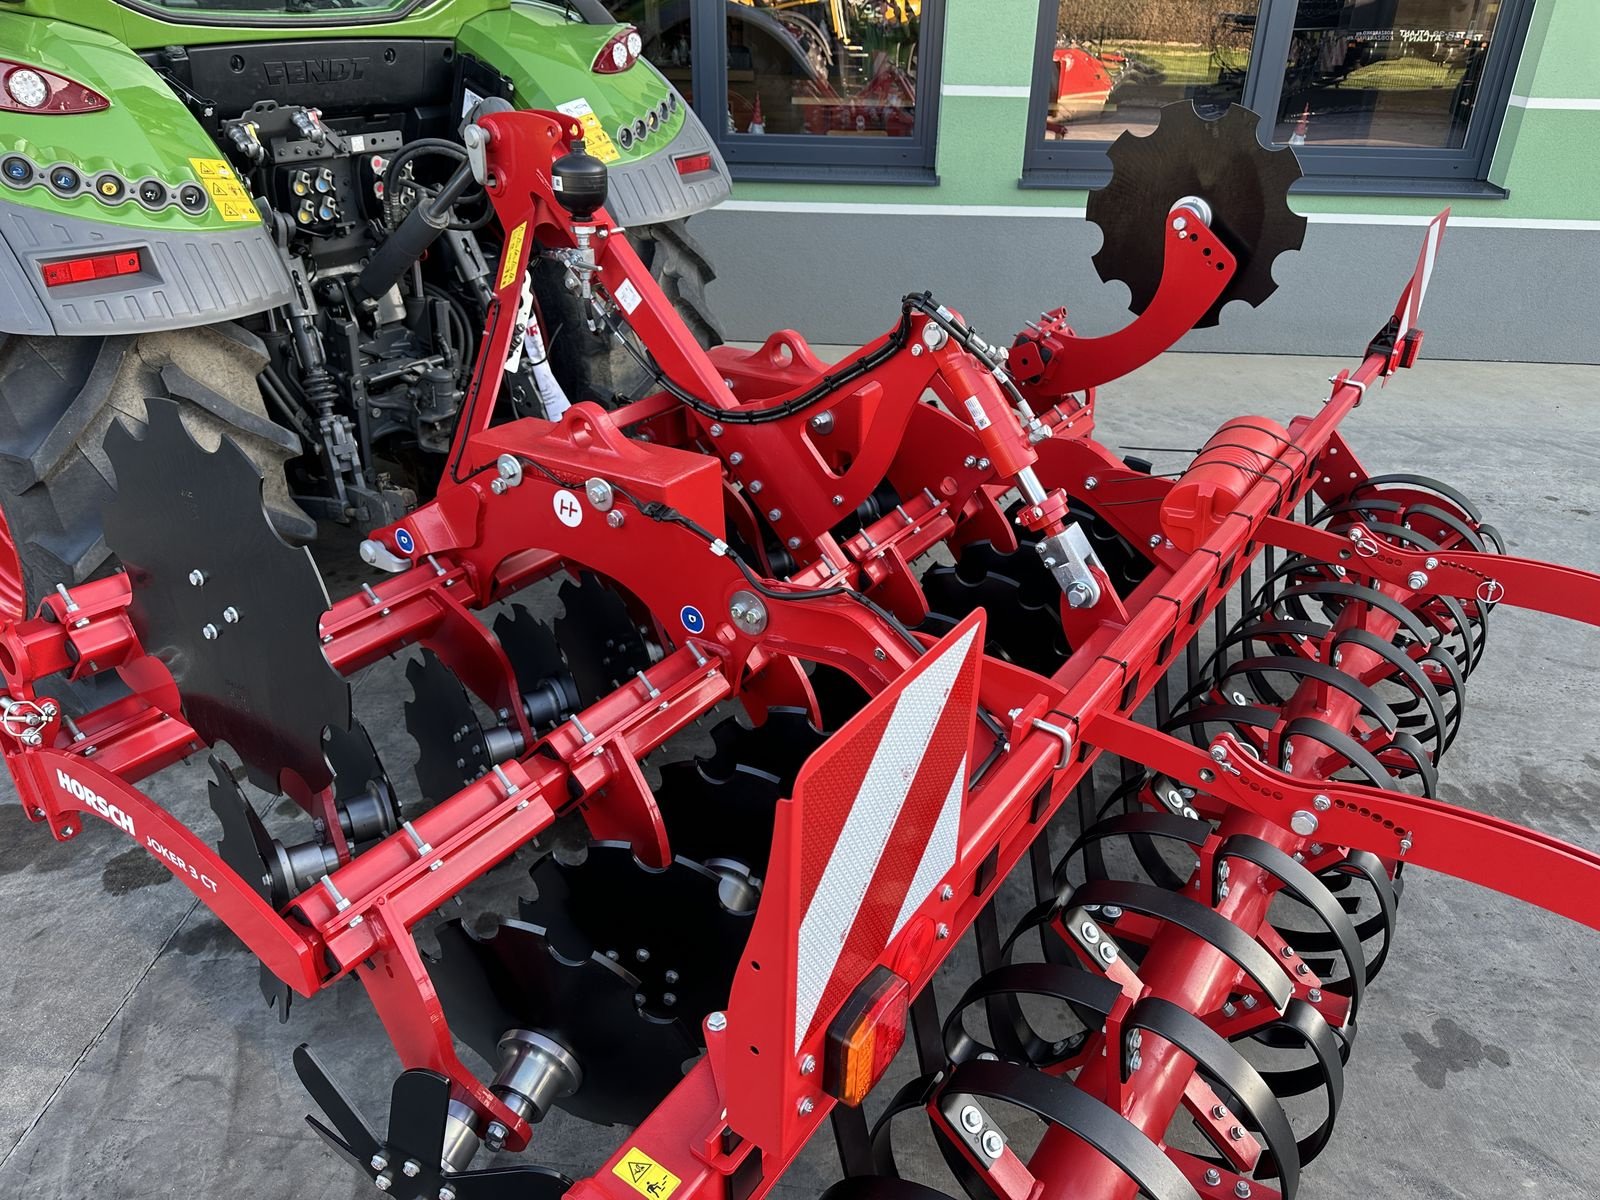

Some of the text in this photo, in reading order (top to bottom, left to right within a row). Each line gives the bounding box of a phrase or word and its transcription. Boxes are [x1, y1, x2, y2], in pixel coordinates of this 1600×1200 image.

[263, 57, 371, 86] FENDT
[56, 768, 135, 836] HORSCH
[146, 835, 217, 893] JOKER 3 CT
